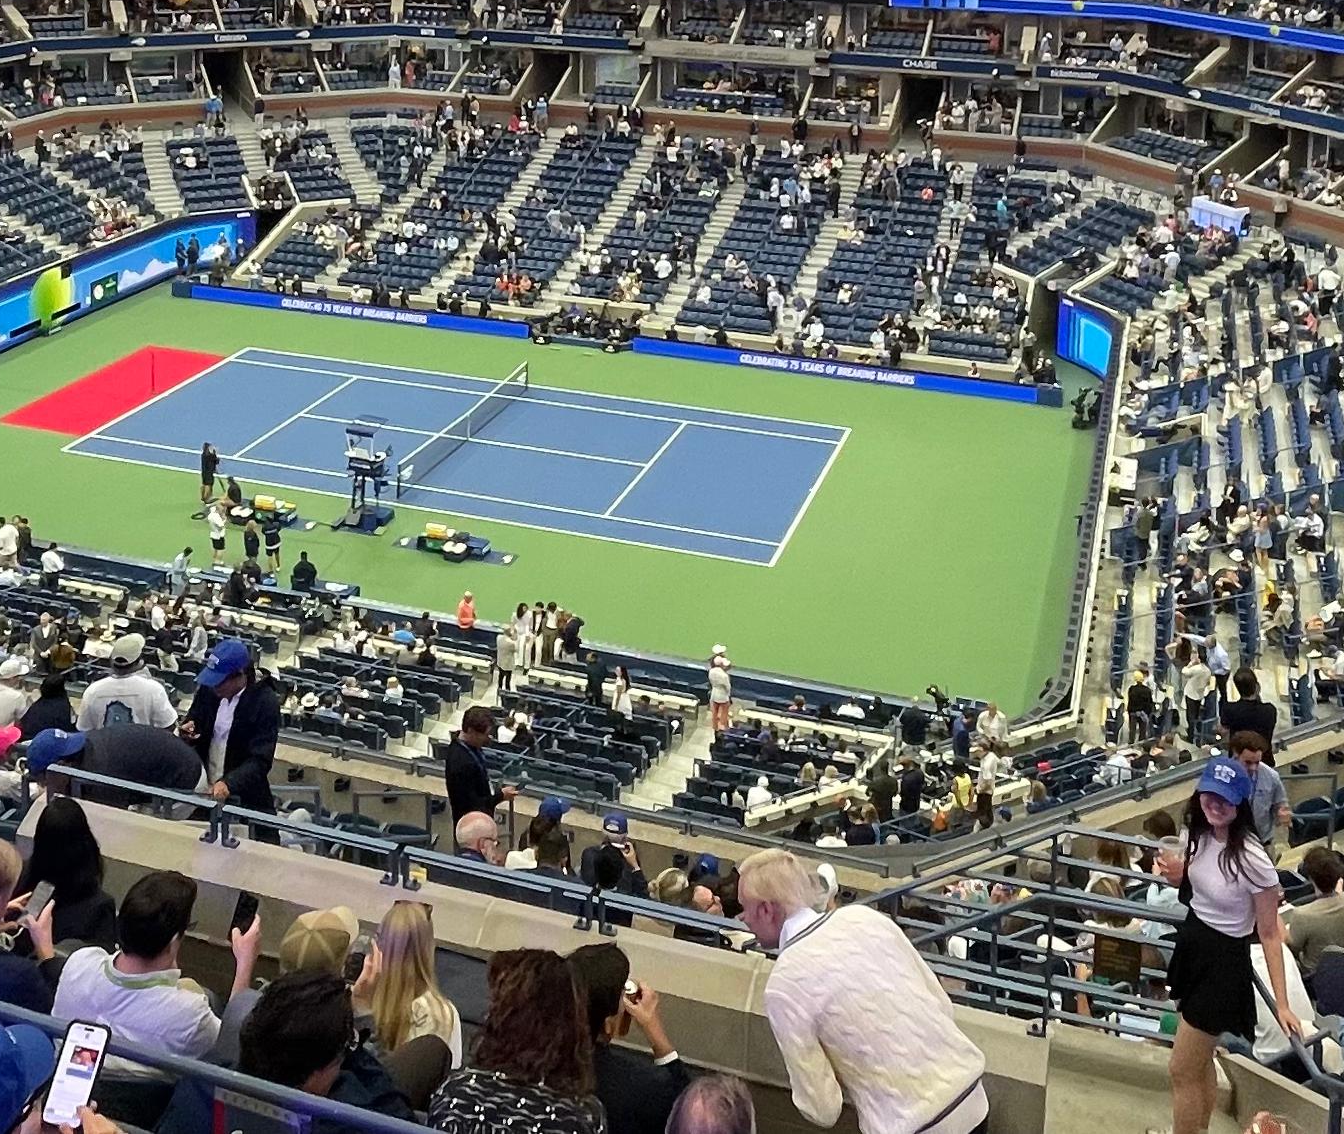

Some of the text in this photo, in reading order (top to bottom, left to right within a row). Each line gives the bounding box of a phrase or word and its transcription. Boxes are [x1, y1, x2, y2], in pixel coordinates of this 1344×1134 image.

[903, 59, 938, 70] CHASE
[739, 353, 915, 385] CELEBRATING 75 YEARS OF BREAKING BARRIERS
